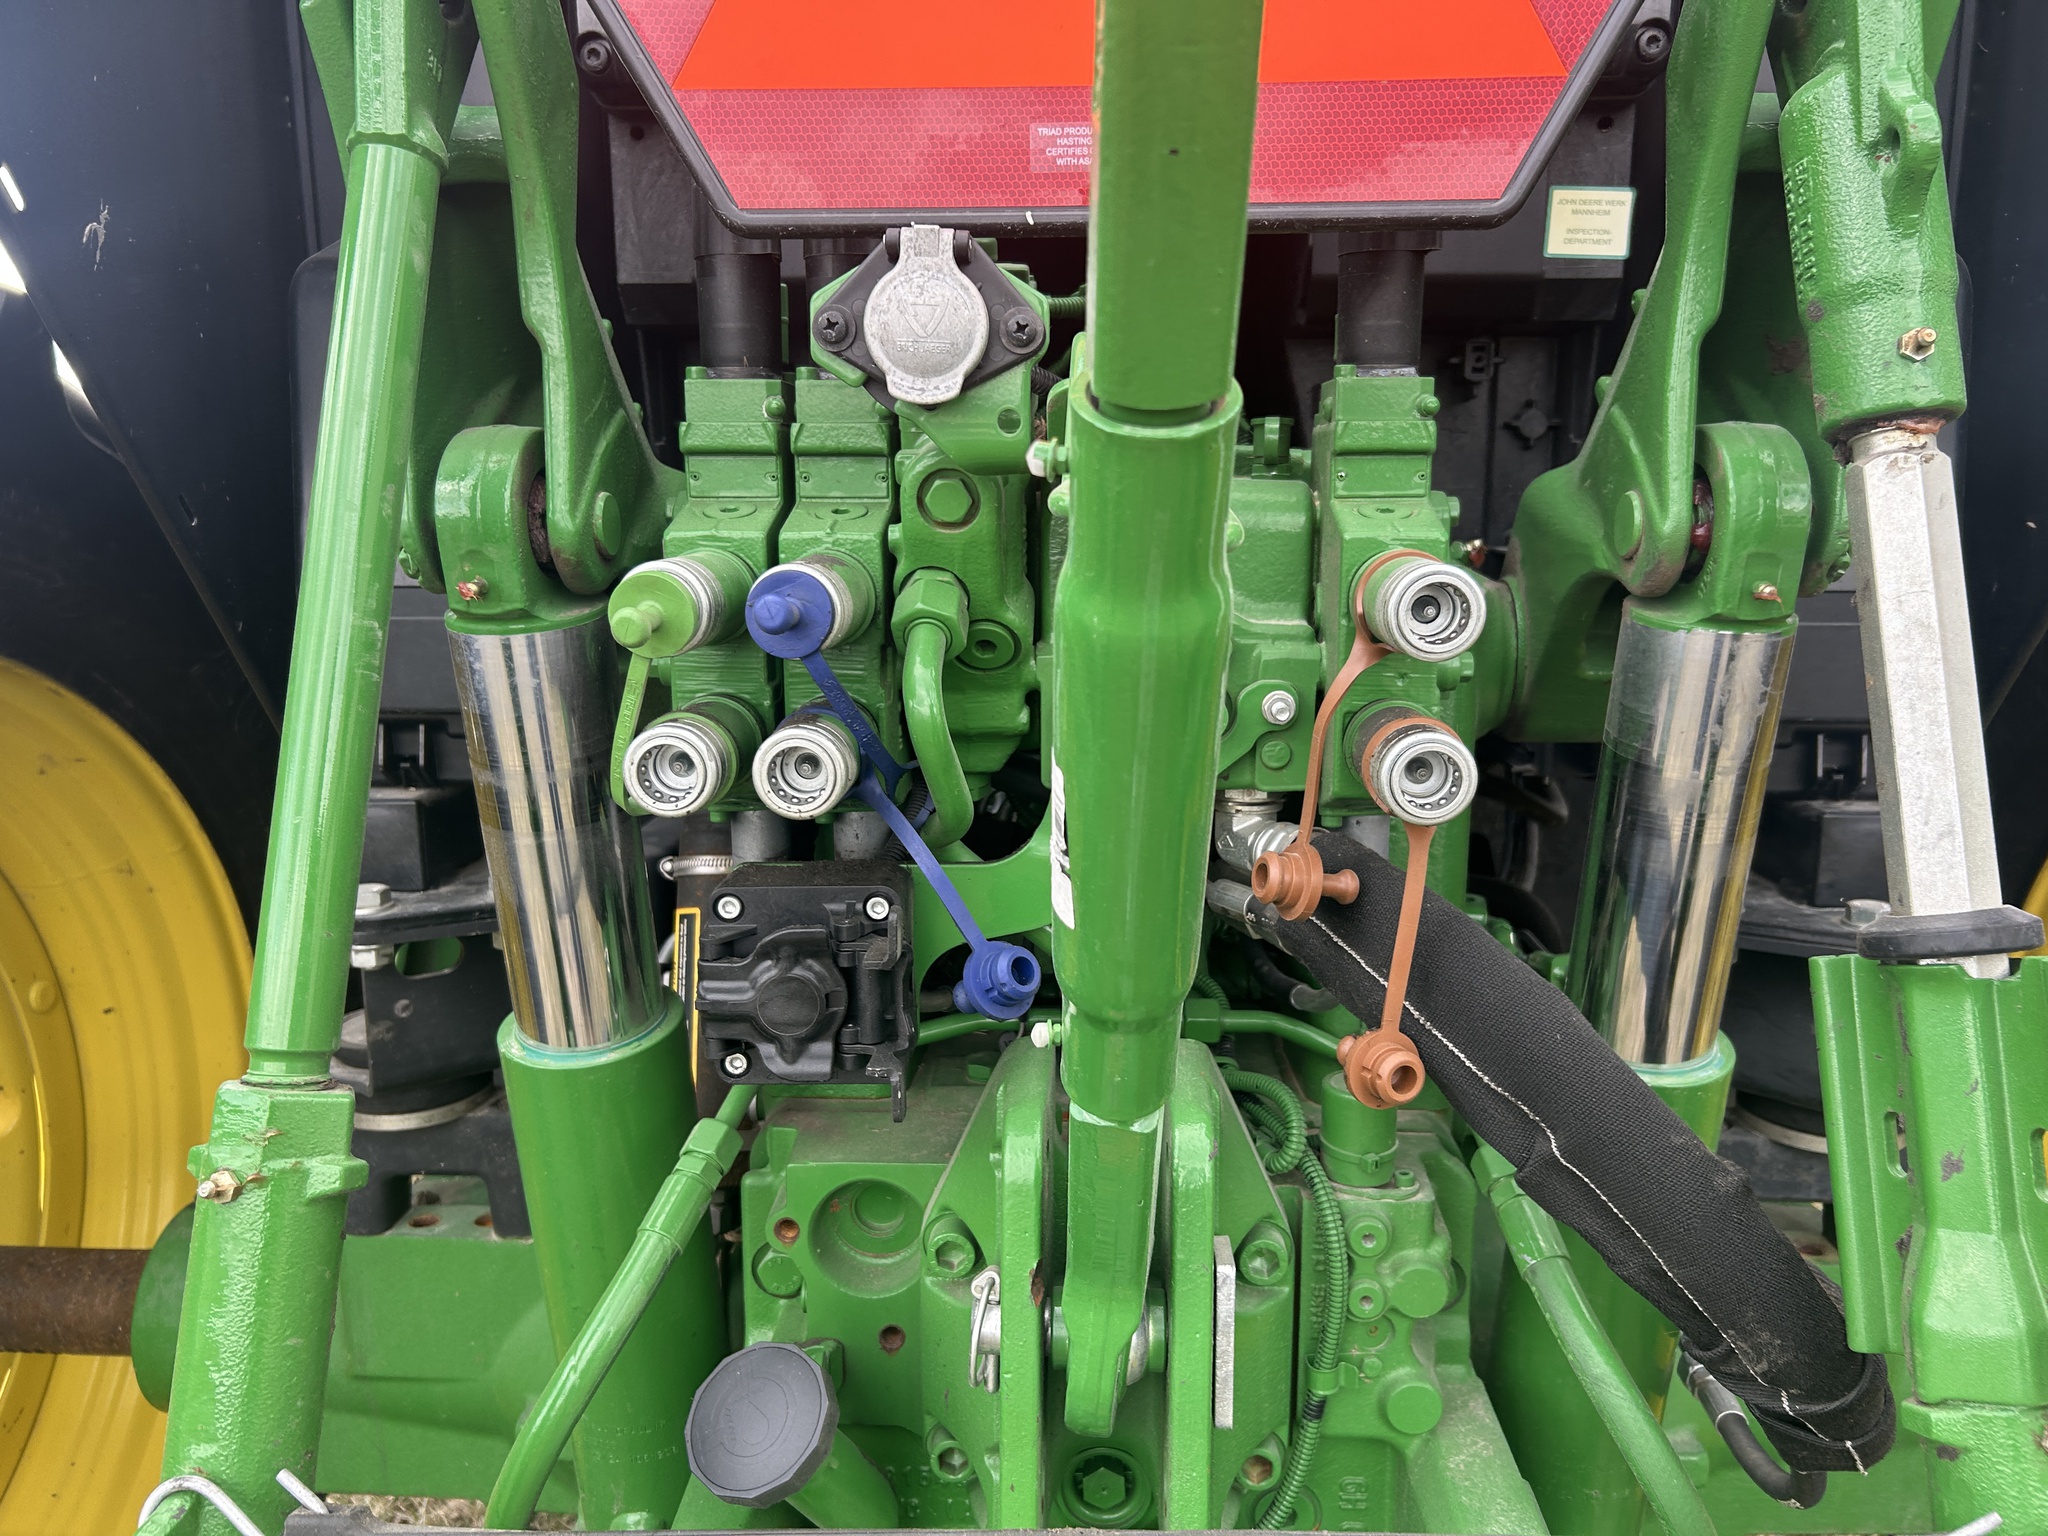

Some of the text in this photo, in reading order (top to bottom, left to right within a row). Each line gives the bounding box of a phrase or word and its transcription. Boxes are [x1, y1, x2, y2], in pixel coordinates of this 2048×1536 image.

[1037, 127, 1093, 136] TRIAD PRODU
[1046, 147, 1088, 156] CERTIFIES
[1056, 157, 1077, 166] WITH
[1557, 198, 1626, 207] JOHN DEERE WERK
[1571, 208, 1611, 216] MANNHEIM
